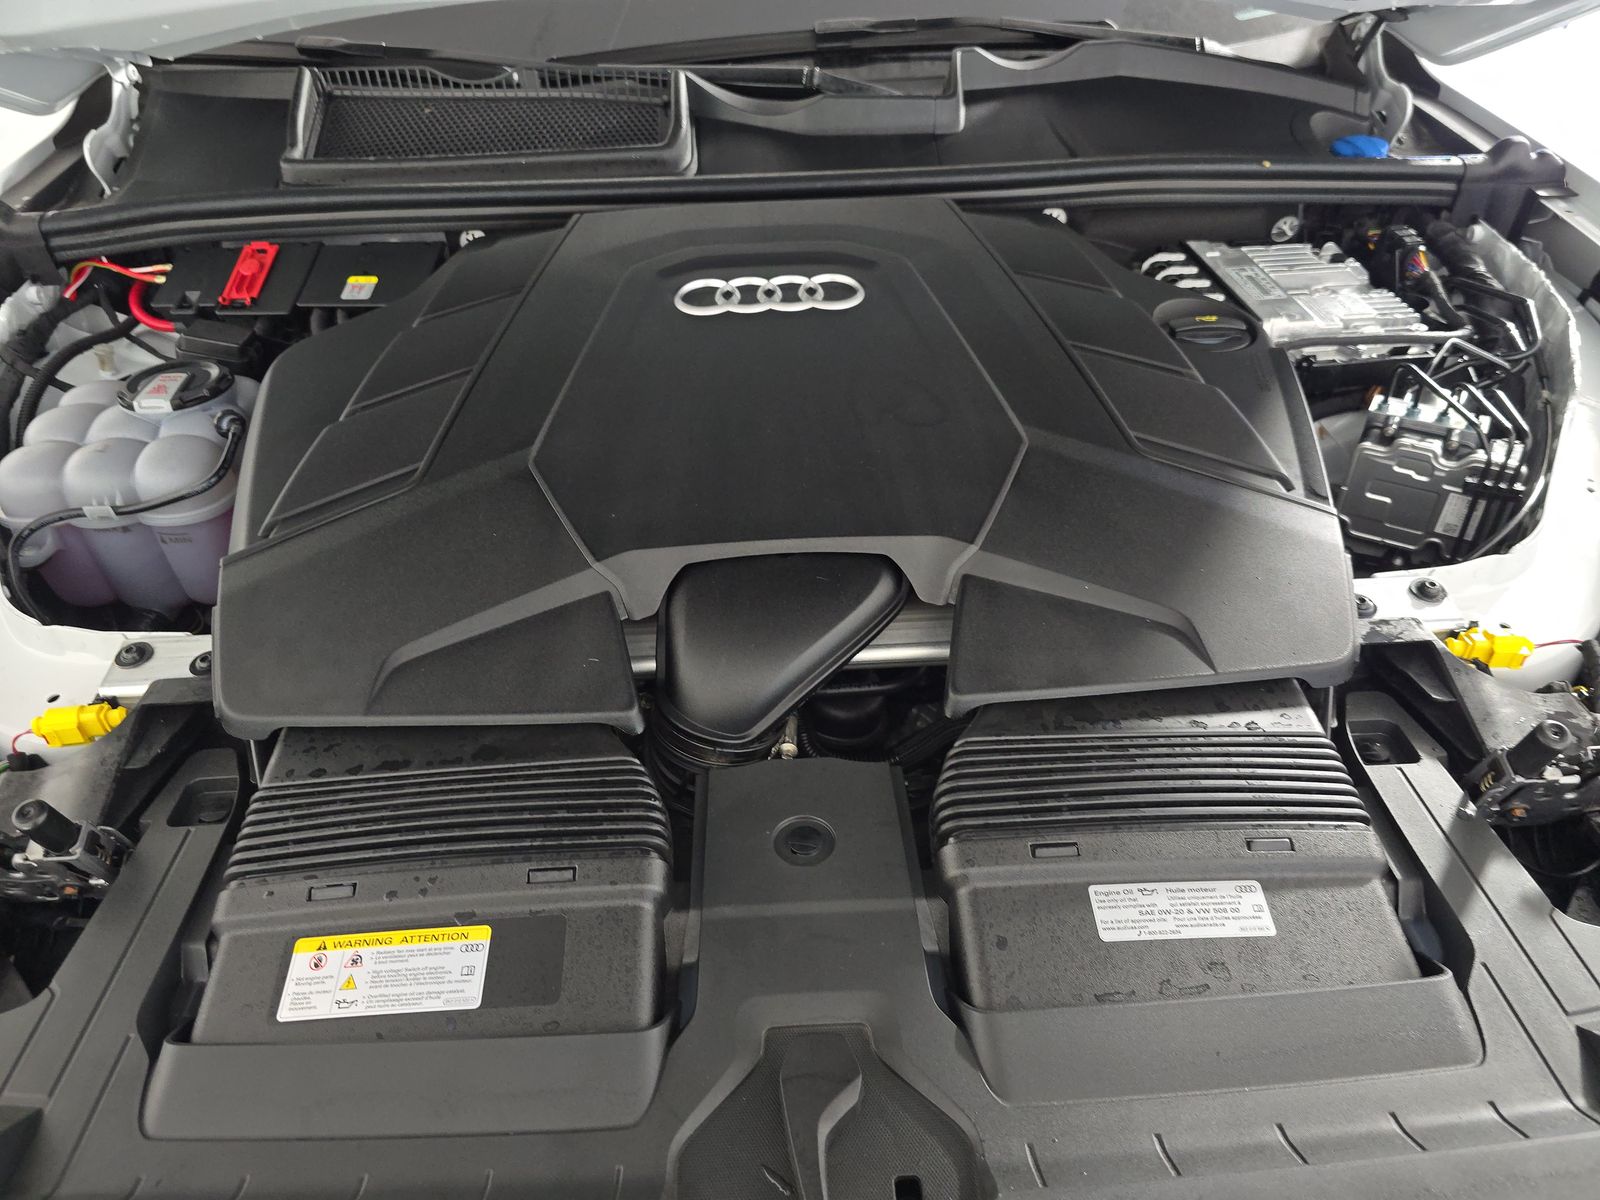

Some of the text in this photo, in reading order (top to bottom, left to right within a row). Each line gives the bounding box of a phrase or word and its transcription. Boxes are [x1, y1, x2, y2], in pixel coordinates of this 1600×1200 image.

[1094, 889, 1121, 897] Engine
[333, 932, 470, 949] WARNING ATTENTION
